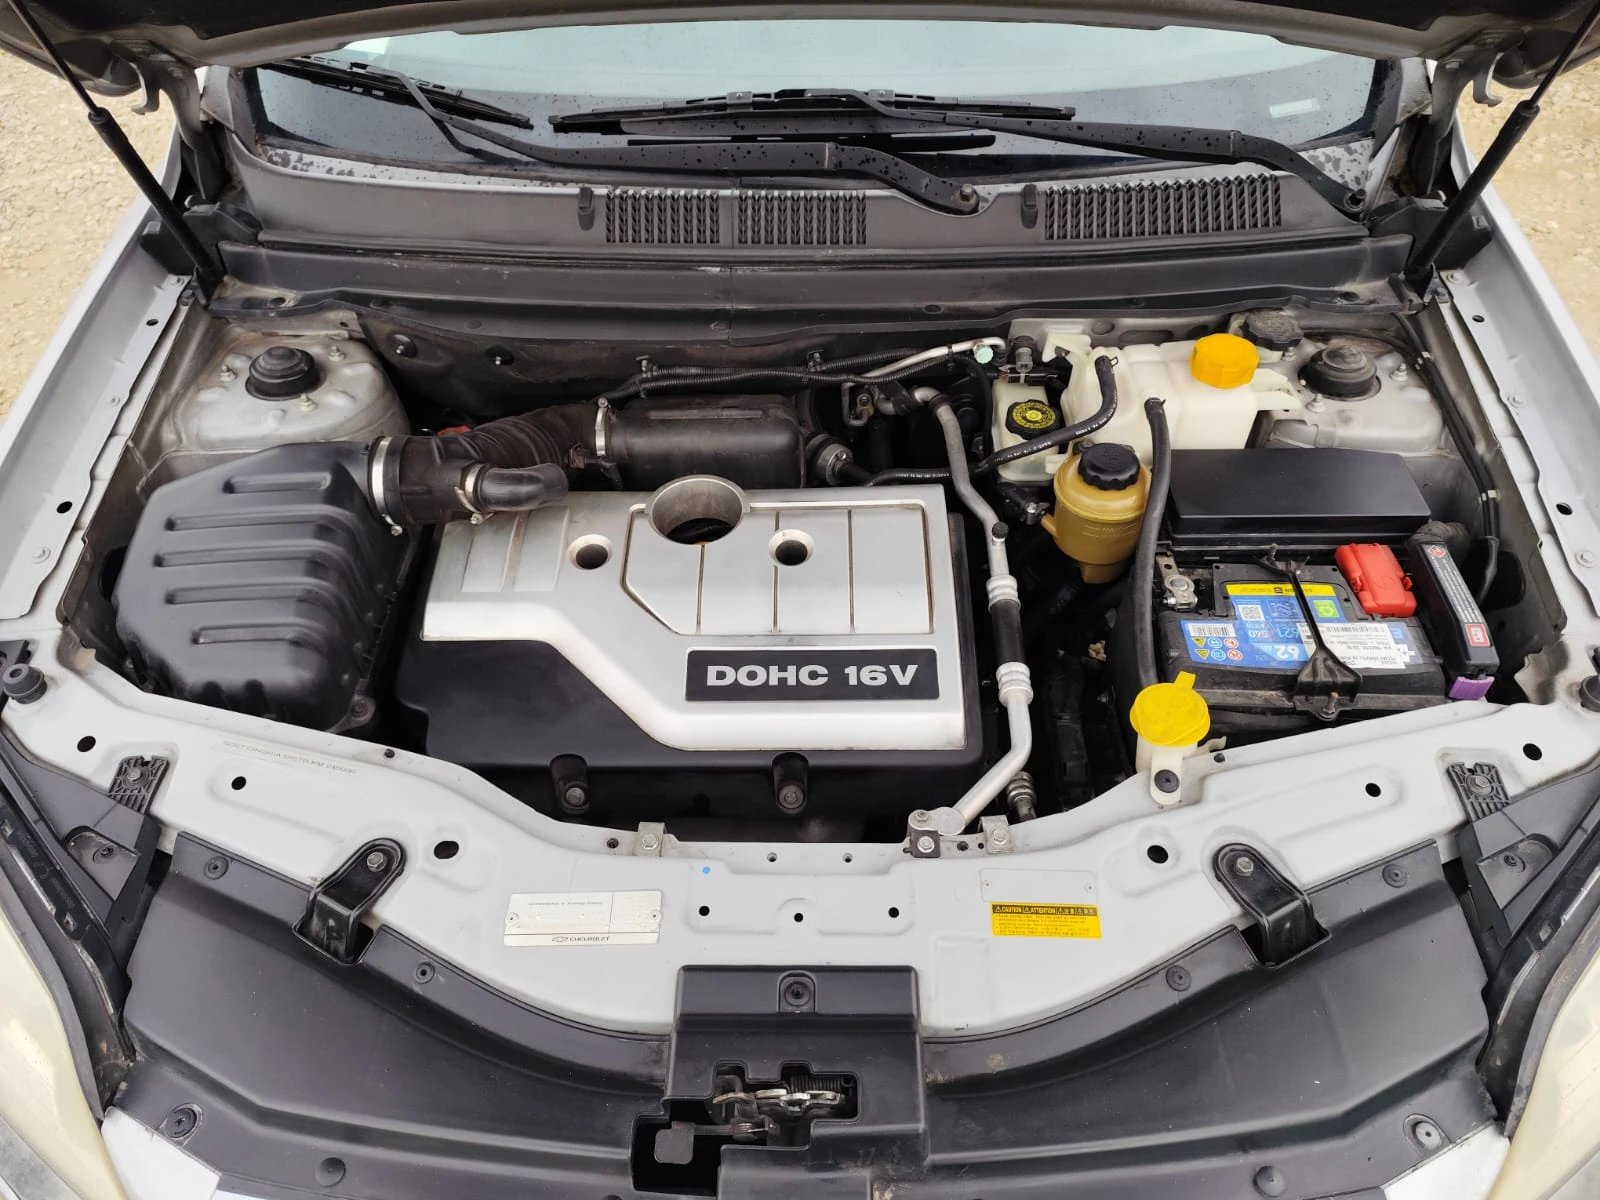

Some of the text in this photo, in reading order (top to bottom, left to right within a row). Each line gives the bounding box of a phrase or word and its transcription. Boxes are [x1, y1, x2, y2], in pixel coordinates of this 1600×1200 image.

[1278, 627, 1300, 638] 621
[1274, 645, 1300, 659] 62
[706, 664, 919, 687] DOHC 16V
[1031, 906, 1056, 914] ATTENTION
